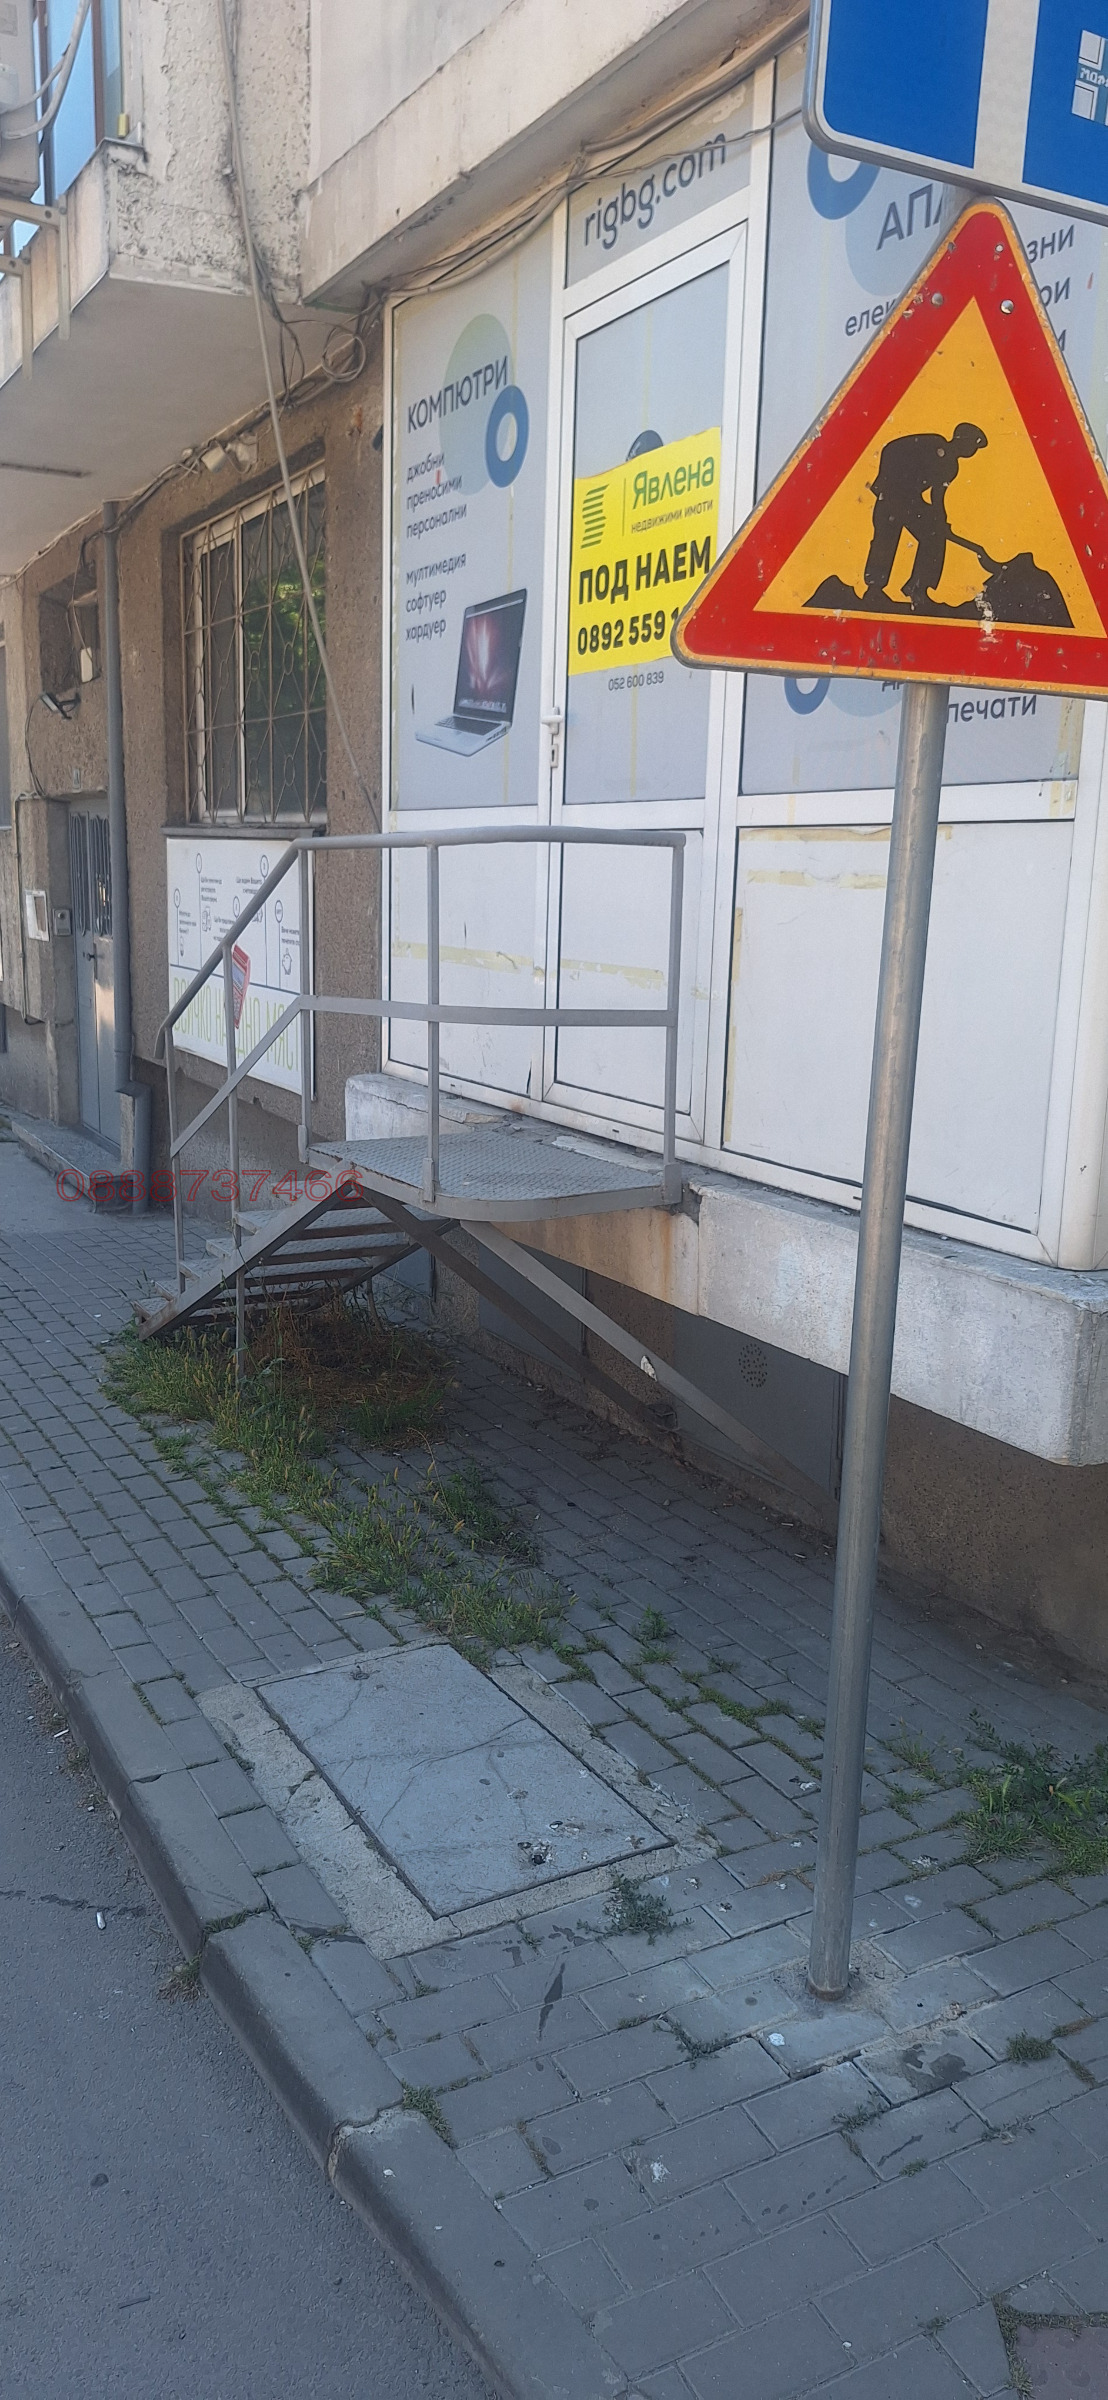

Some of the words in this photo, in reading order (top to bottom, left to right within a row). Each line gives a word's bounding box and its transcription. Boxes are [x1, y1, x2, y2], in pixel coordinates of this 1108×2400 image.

[585, 132, 726, 250] rigbg.com
[408, 355, 508, 434] КОМПЮТРИ
[407, 452, 445, 483] джобни
[633, 456, 715, 510] Явлена
[406, 474, 463, 513] преносими
[406, 503, 467, 540] персонални
[631, 509, 682, 535] недвижими
[684, 500, 714, 519] имоти
[406, 553, 467, 588] мултимедия
[579, 559, 629, 605] ПОД
[635, 535, 711, 591] НАЕМ
[406, 589, 447, 615] софтуер
[406, 618, 447, 644] хардуер
[577, 619, 624, 655] 0892
[628, 610, 666, 646] 559
[608, 678, 625, 692] 052
[626, 674, 645, 689] 600
[646, 671, 665, 686] 839
